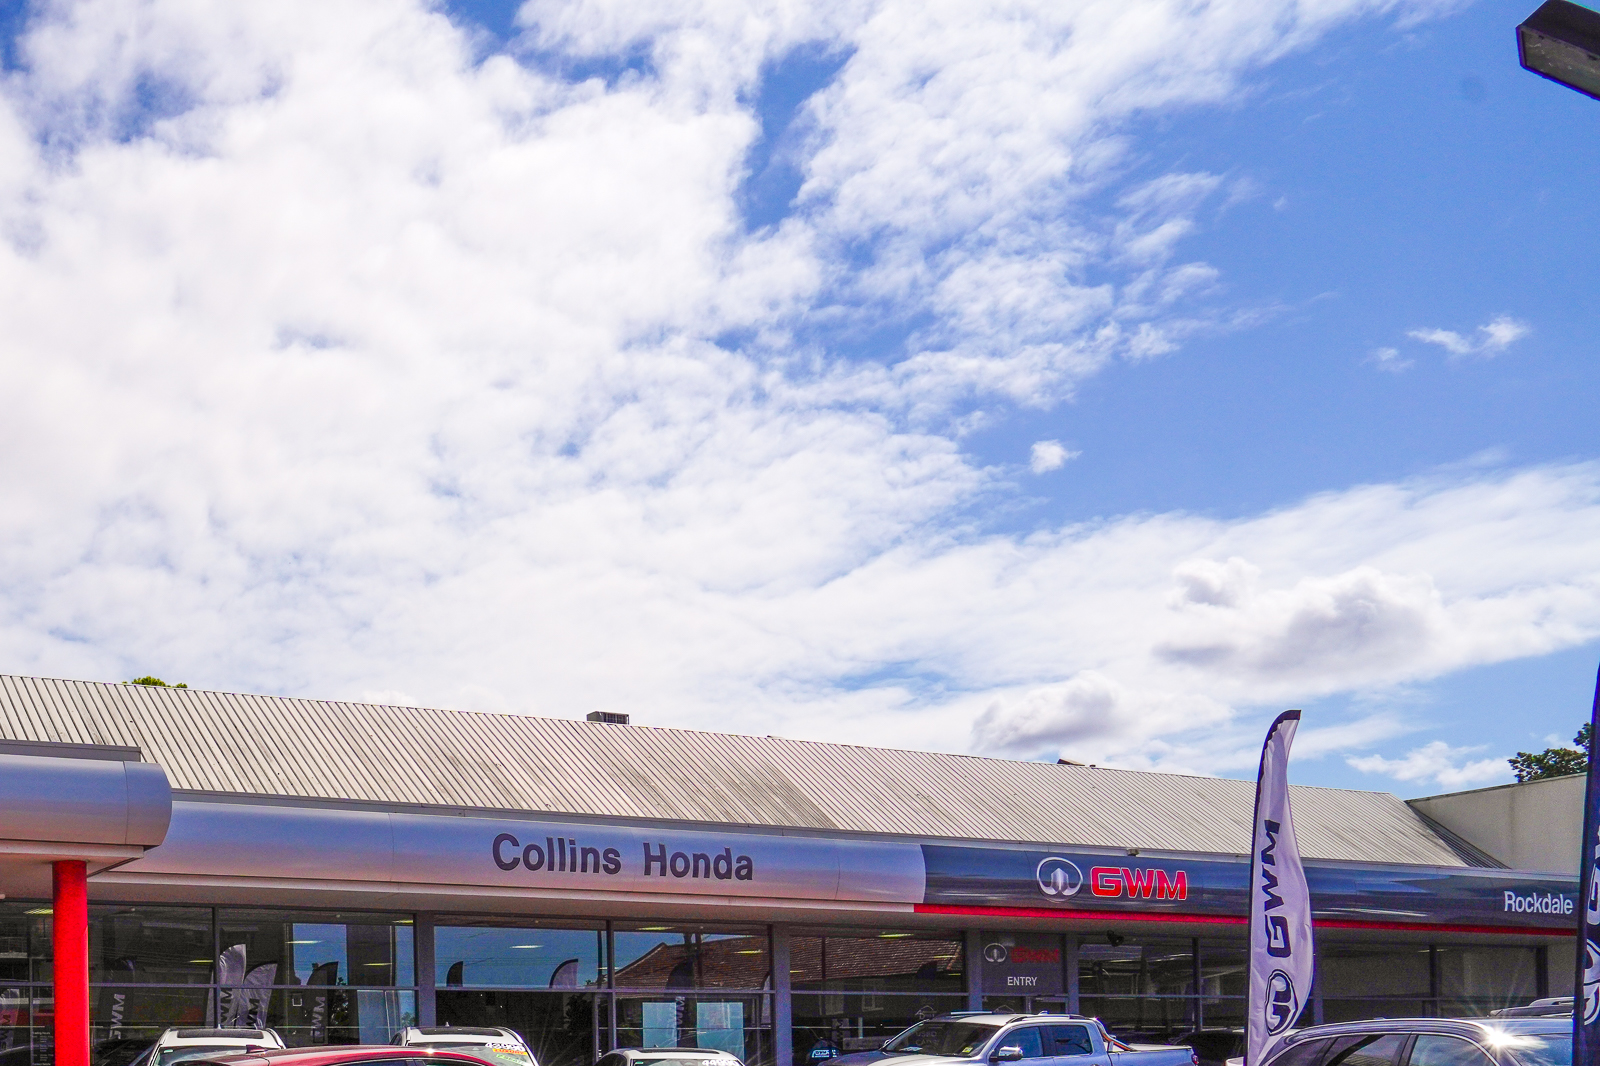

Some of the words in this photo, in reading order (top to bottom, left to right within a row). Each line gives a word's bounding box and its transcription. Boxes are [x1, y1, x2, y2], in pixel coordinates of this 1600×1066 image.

[492, 833, 622, 875] Collins
[642, 842, 753, 881] Honda
[1090, 866, 1188, 901] GWM
[1260, 819, 1292, 958] GWM
[1503, 890, 1574, 915] Rockdale
[1007, 976, 1038, 986] ENTRY
